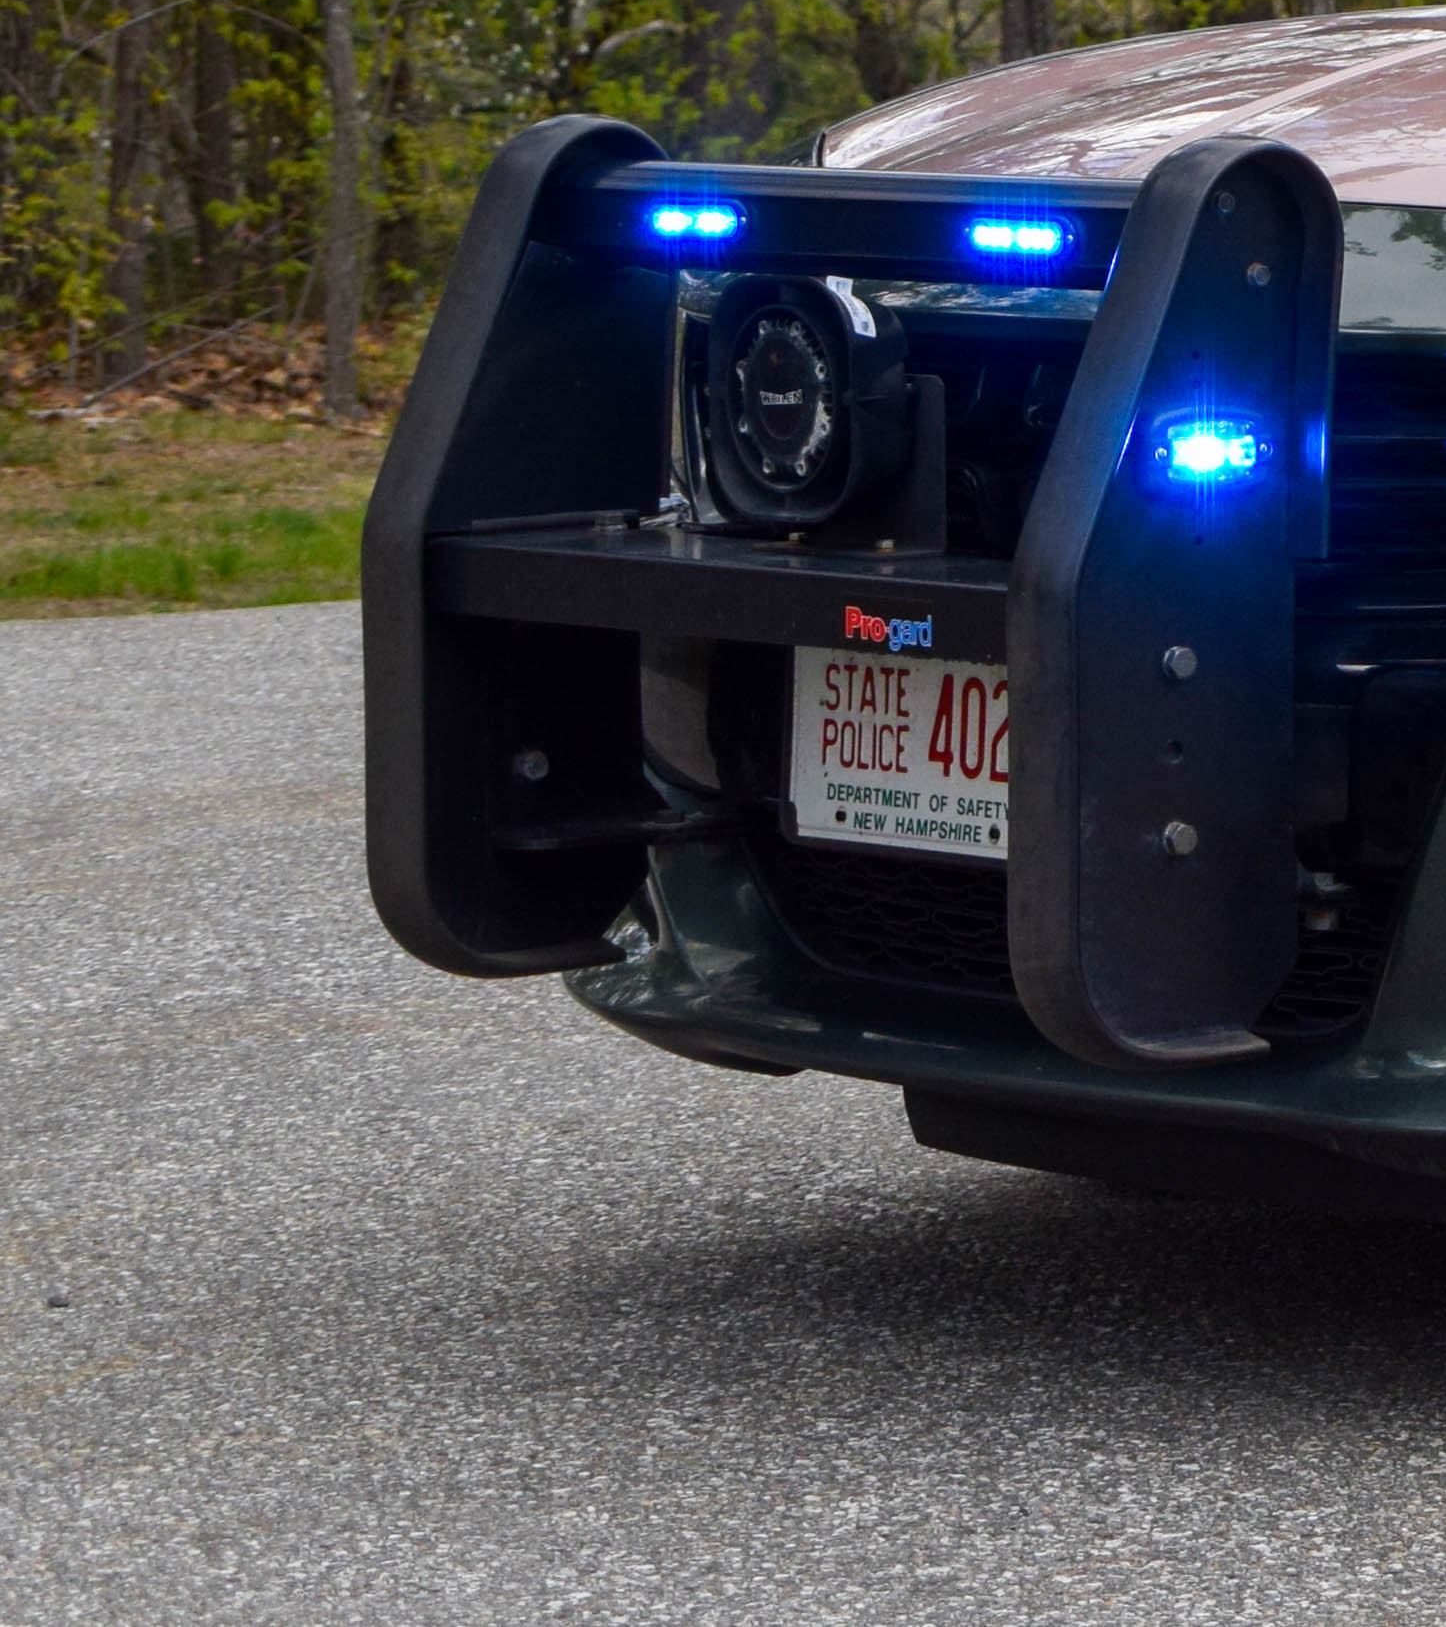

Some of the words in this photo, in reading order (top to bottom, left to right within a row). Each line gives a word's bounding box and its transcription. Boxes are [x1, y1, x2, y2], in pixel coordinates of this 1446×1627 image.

[845, 606, 932, 652] Pro-gard
[824, 663, 910, 717] STATE
[821, 718, 910, 774] POLICE
[826, 783, 921, 810] DEPARTMENT
[929, 794, 948, 813] OF
[853, 811, 888, 832] NEW
[895, 816, 982, 843] HAMPSHIRE
